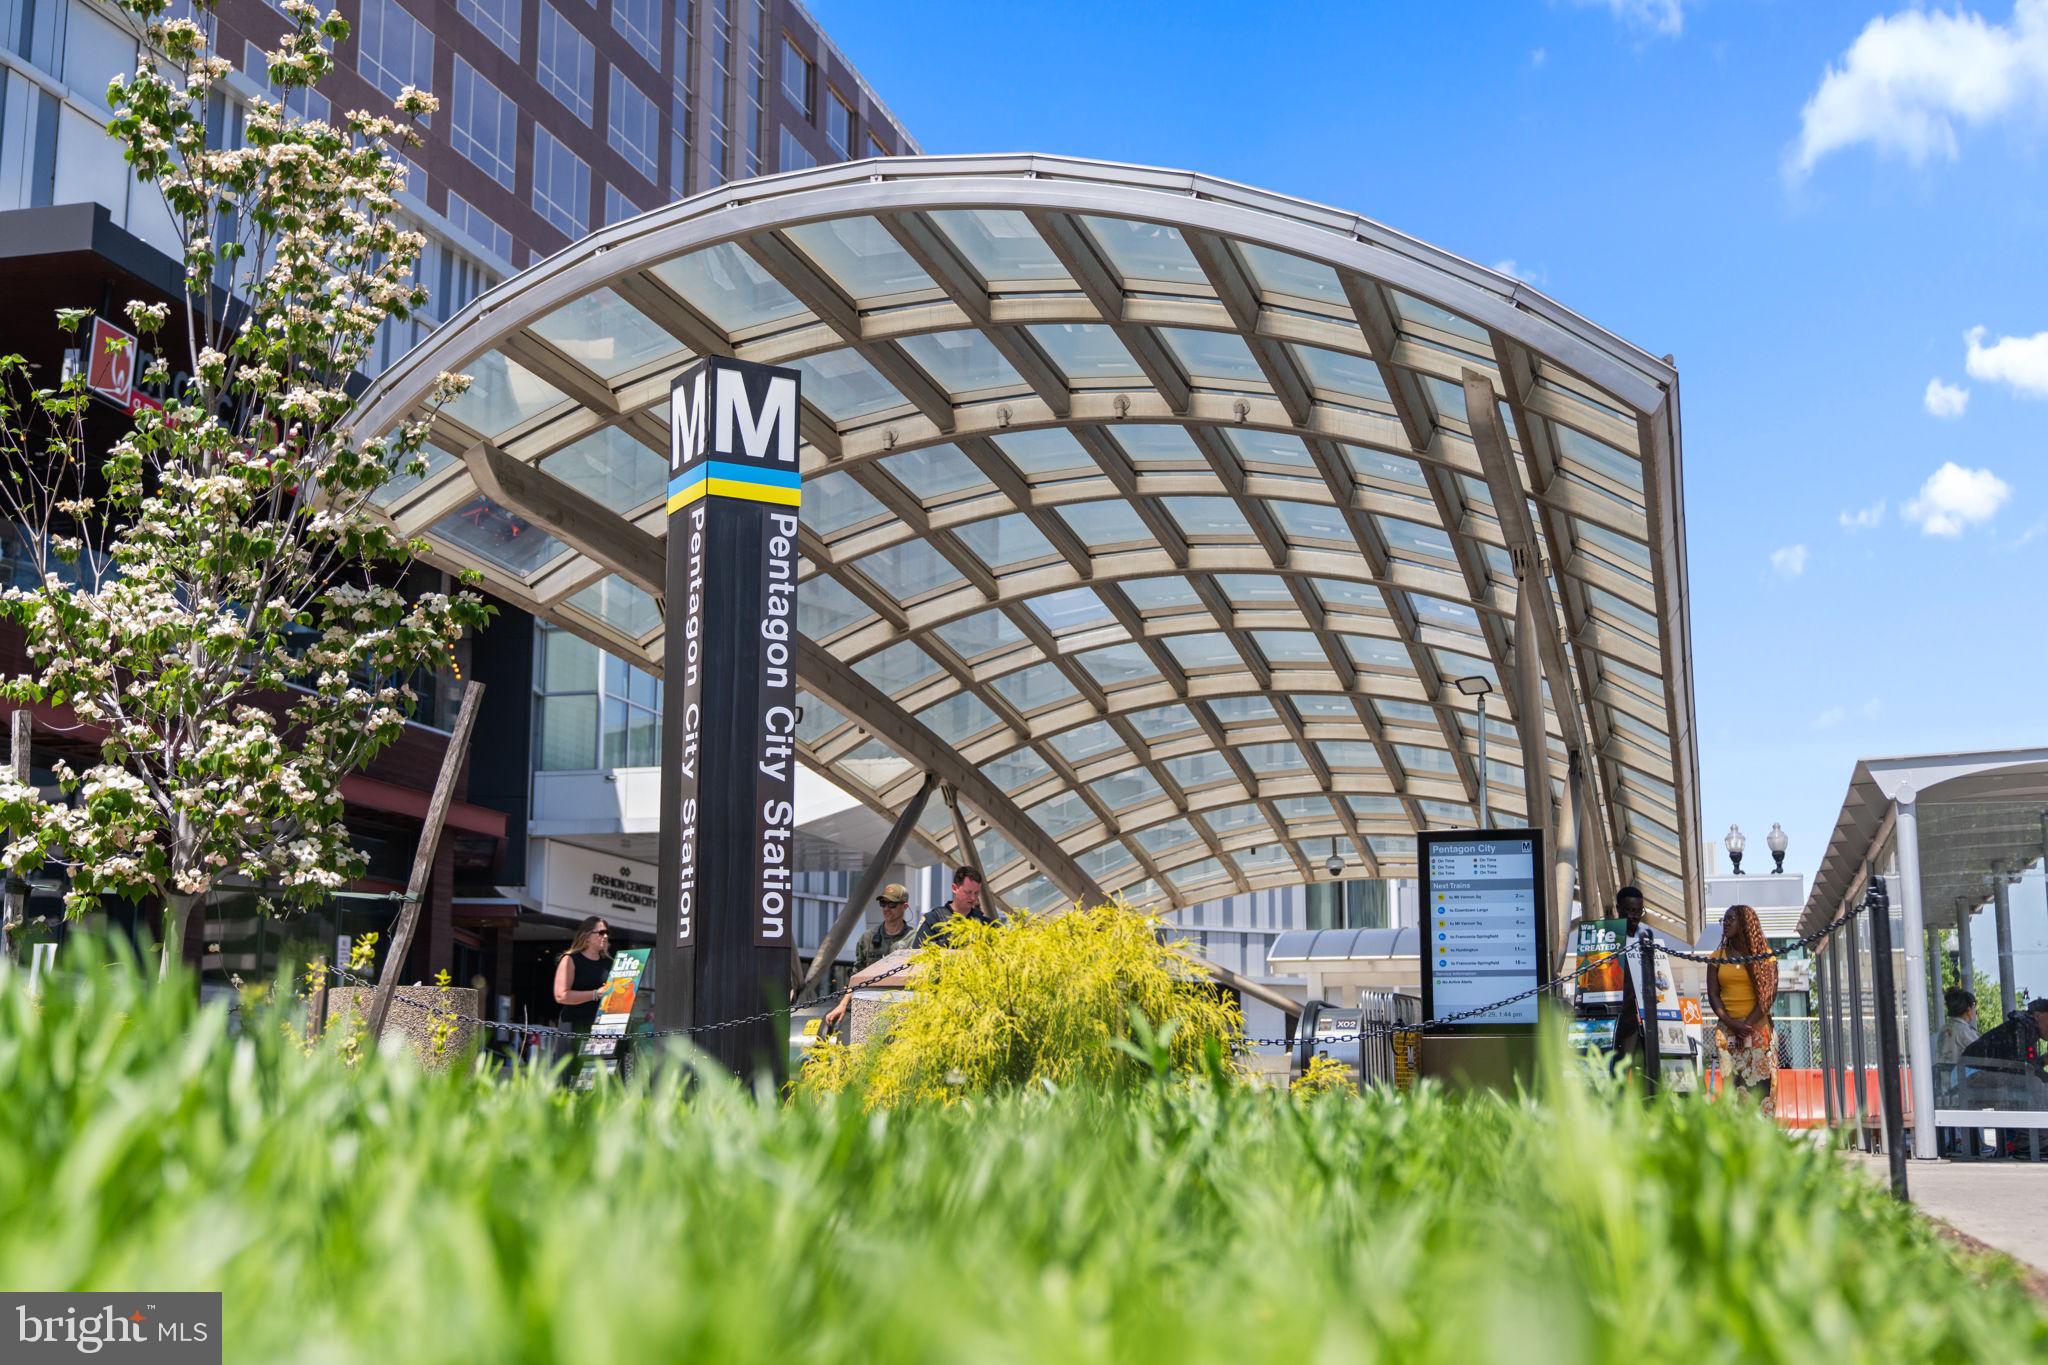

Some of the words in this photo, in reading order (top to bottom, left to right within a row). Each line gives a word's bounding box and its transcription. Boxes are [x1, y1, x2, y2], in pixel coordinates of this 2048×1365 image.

[672, 370, 706, 471] M
[715, 367, 796, 462] M
[685, 506, 705, 687] Pentagon
[761, 512, 798, 688] Pentagon
[681, 703, 699, 779] City
[759, 706, 794, 782] City
[593, 873, 625, 889] FASHION
[626, 881, 656, 896] CENTRE
[679, 798, 696, 939] Station
[762, 799, 793, 938] Station
[1432, 845, 1475, 855] Pentagon
[1478, 844, 1496, 854] City
[589, 886, 600, 896] AT
[601, 888, 641, 906] PENTAGON
[613, 957, 640, 971] Life
[1579, 942, 1621, 952] CREATED?
[1580, 928, 1616, 944] Life
